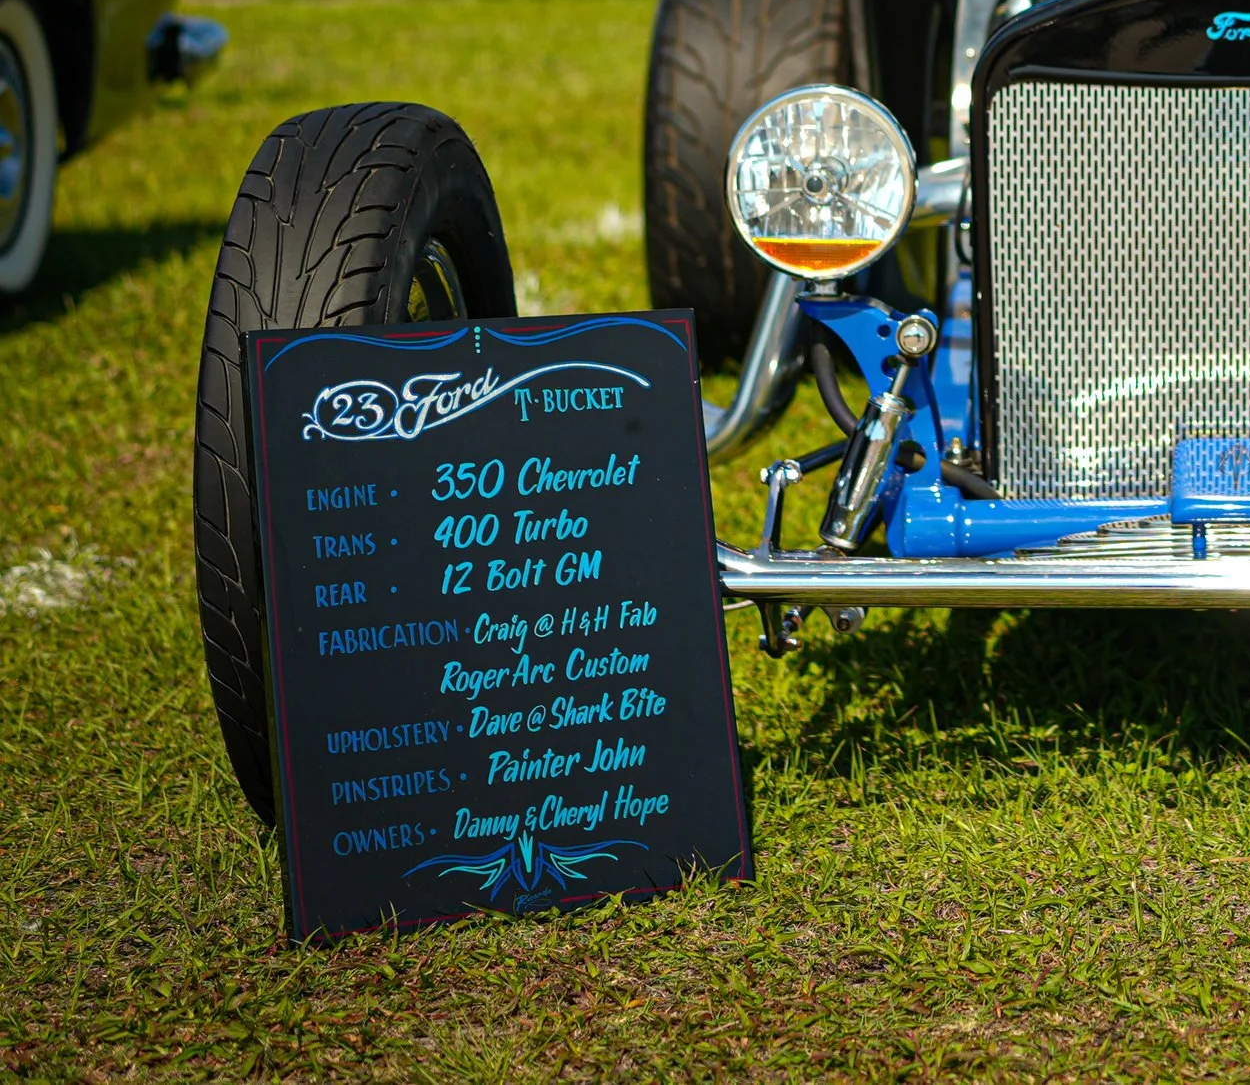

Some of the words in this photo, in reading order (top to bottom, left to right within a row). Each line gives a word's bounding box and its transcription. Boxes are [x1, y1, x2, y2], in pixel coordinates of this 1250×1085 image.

[332, 393, 385, 430] 23
[393, 368, 499, 440] Ford
[307, 484, 377, 510] ENGINE
[432, 459, 505, 501] 350
[518, 454, 640, 495] Chevrolet
[313, 533, 376, 558] TRANS
[434, 514, 499, 548] 400
[514, 509, 588, 544] Turbo
[315, 581, 367, 607] REAR
[442, 562, 473, 594] 12
[487, 559, 547, 591] Bolt
[555, 550, 602, 586] GM
[319, 619, 458, 655] FABRICATION
[474, 613, 528, 654] Craig
[534, 614, 554, 637] @
[620, 601, 657, 629] Fab
[440, 661, 510, 700] Roger
[512, 653, 555, 687] Arc
[566, 648, 649, 681] Custom
[328, 721, 449, 753] UPHOLSTERY
[469, 706, 523, 738] Dave
[527, 705, 546, 732] @
[549, 696, 613, 729] Shark
[620, 688, 666, 720] Bite
[332, 769, 450, 804] PINSTRIPES
[488, 748, 581, 785] Painter
[584, 738, 645, 772] John
[334, 823, 424, 854] OWNERS
[454, 807, 520, 841] Danny
[614, 785, 669, 826] Hope
